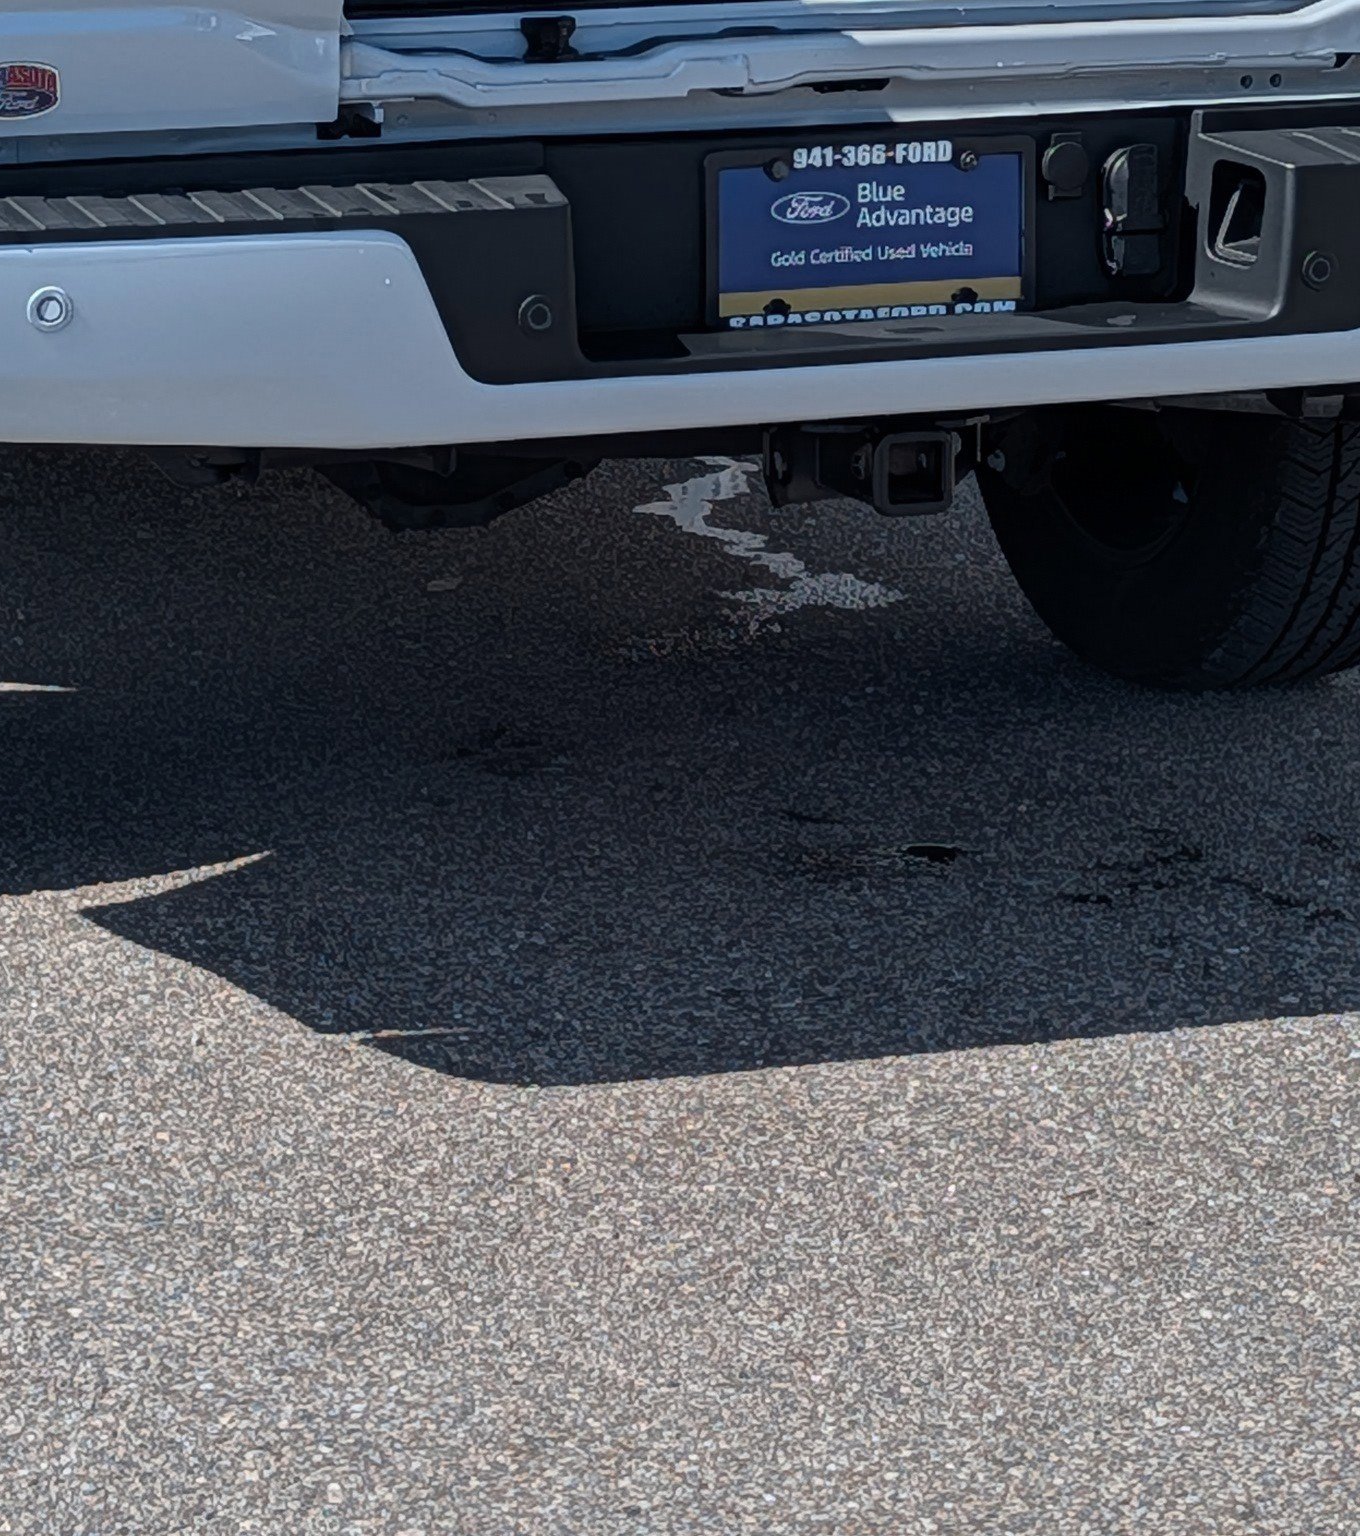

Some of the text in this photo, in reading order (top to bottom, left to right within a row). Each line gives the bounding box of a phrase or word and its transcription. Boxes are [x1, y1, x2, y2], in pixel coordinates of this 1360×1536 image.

[793, 140, 953, 169] 941-366-FORD
[857, 181, 906, 203] Blue
[786, 195, 835, 221] Ford
[856, 203, 974, 228] Advantage
[771, 251, 806, 268] Gold
[810, 246, 872, 266] Certified
[877, 243, 916, 261] Used
